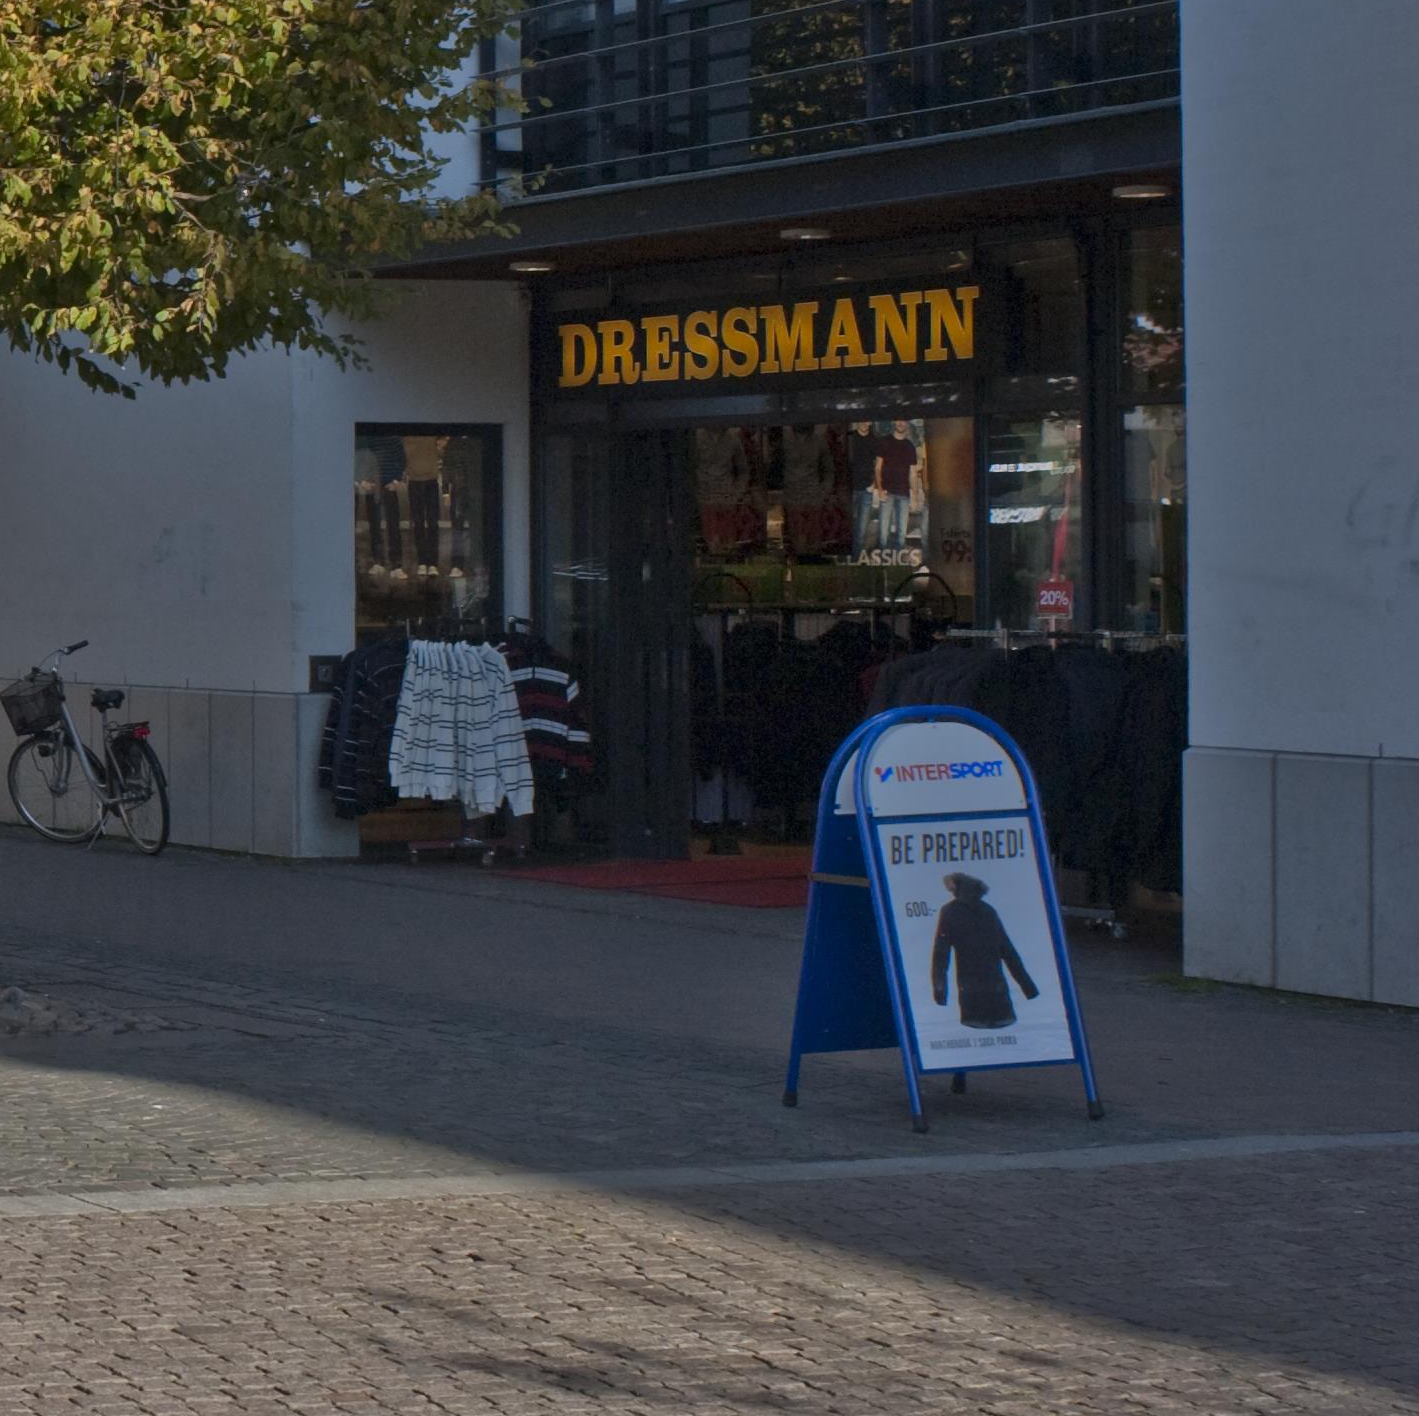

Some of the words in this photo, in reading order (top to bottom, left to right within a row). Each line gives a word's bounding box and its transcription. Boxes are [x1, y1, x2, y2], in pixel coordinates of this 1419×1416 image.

[559, 286, 980, 387] DRESSMANN
[1039, 589, 1069, 606] 20%
[895, 760, 1003, 782] INTERSPORT
[891, 834, 914, 865] BE
[923, 828, 1024, 863] PREPARED!
[906, 900, 938, 918] 600:-
